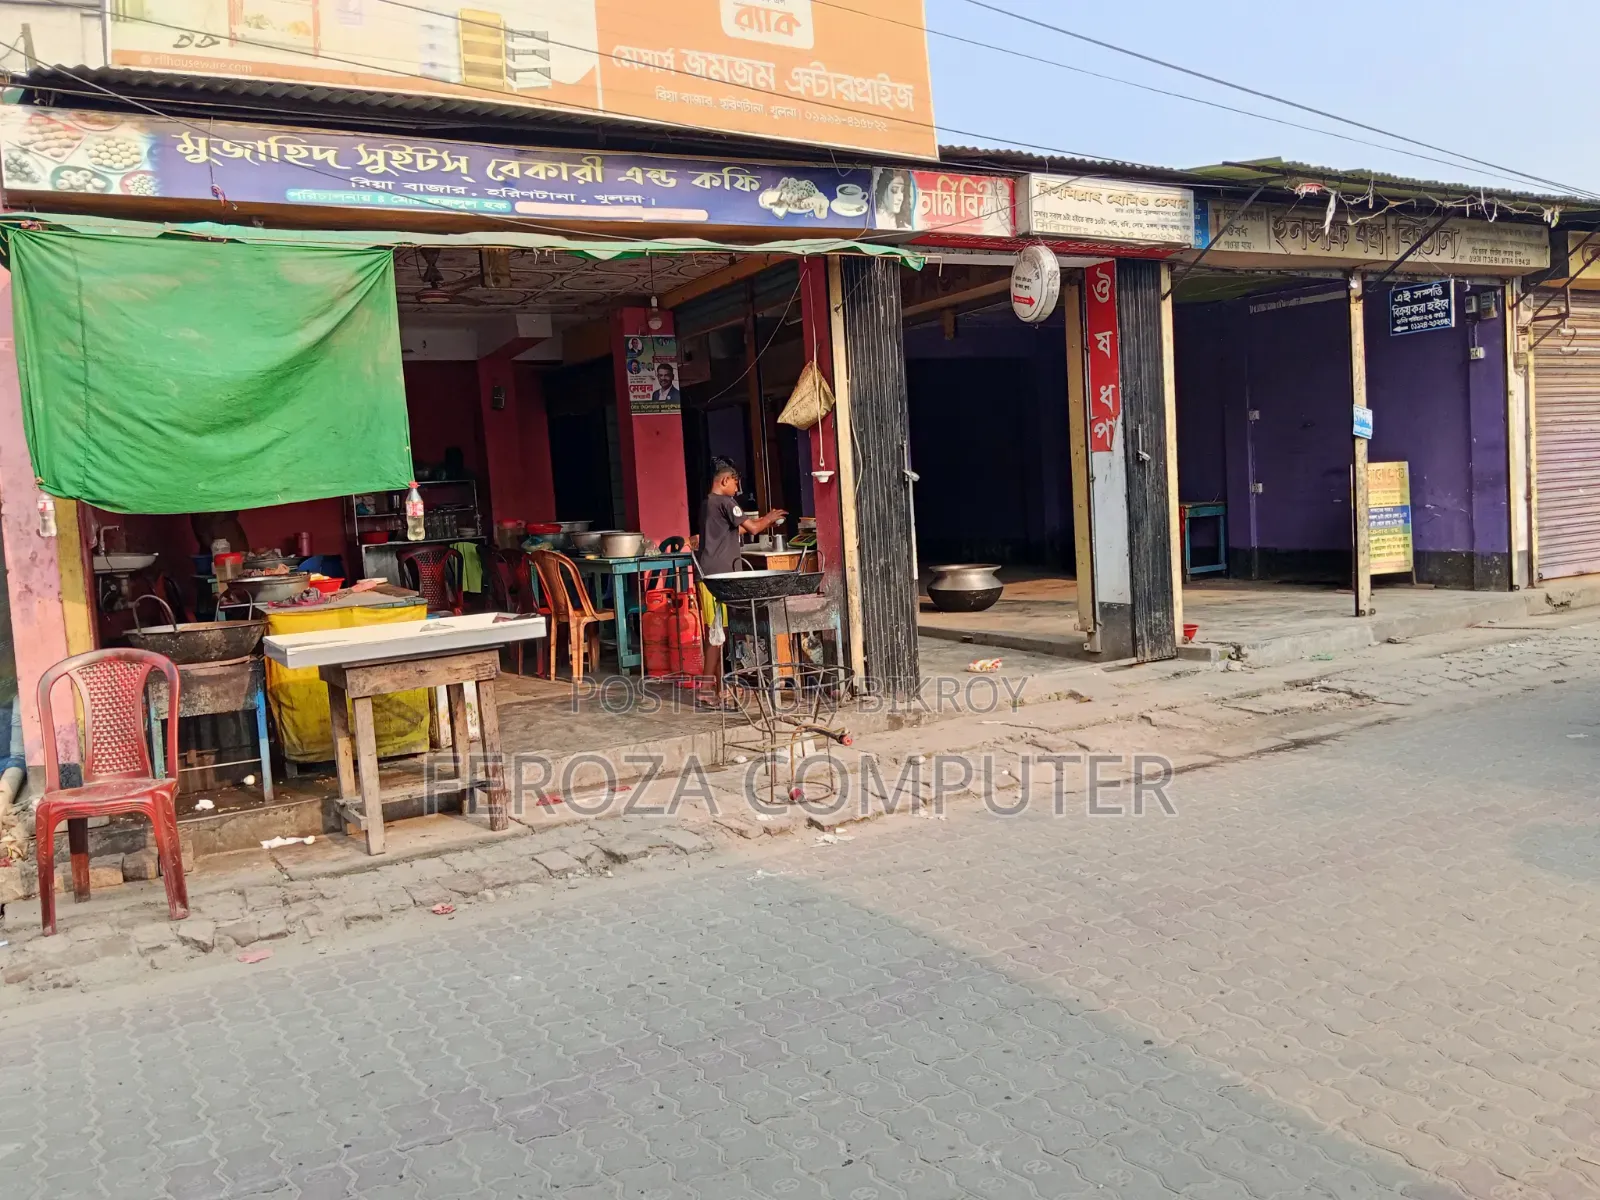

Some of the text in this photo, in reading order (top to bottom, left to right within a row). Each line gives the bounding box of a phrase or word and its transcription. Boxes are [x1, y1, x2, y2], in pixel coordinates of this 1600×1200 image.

[611, 45, 914, 112] মেসার্স জমজম এন্টারপ্রাইজ
[171, 131, 352, 170] মুজাহিদ
[486, 156, 604, 185] বেকারী
[617, 167, 678, 188] এন্ড
[688, 166, 761, 192] কফি
[350, 176, 396, 190] রিয়া
[1394, 284, 1443, 303] এই সম্পত্তি
